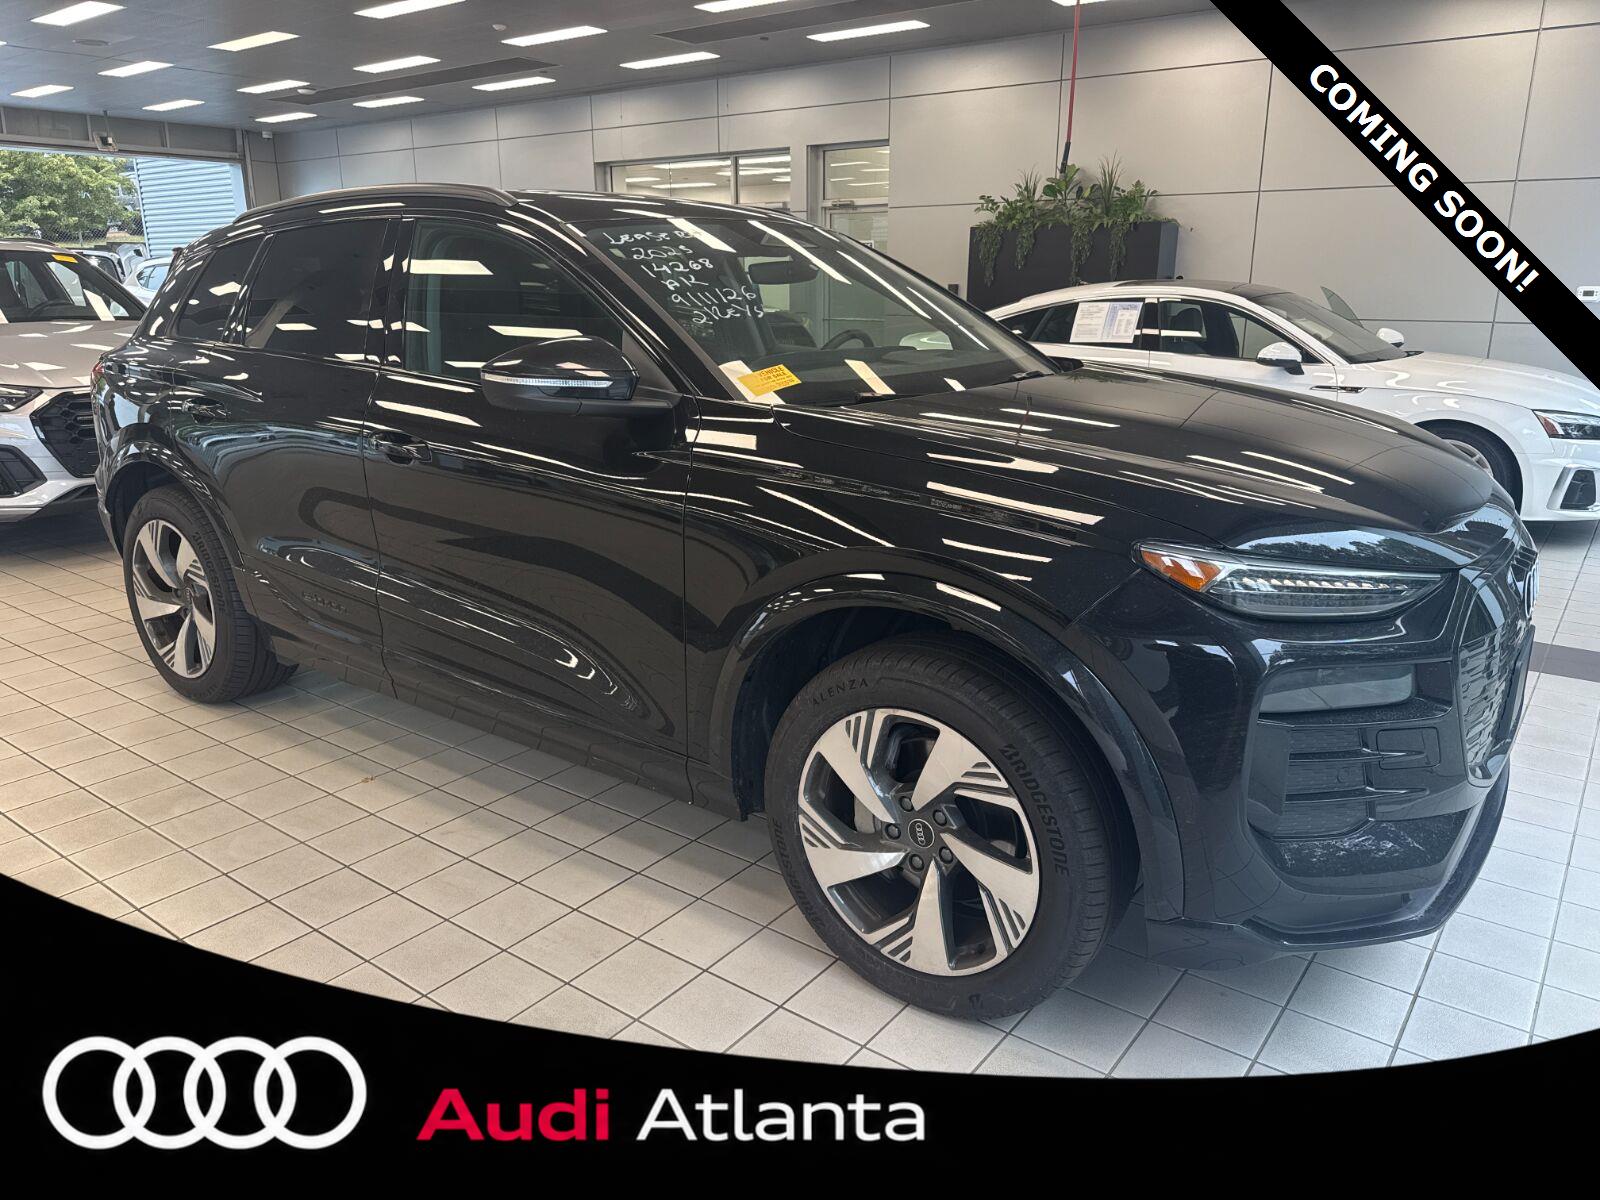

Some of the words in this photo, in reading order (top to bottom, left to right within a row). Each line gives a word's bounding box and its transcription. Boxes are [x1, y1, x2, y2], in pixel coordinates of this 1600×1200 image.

[632, 245, 693, 260] 2025
[641, 258, 713, 278] 14268
[811, 678, 868, 705] ALENZA
[1000, 743, 1070, 877] BRIDGESTONE
